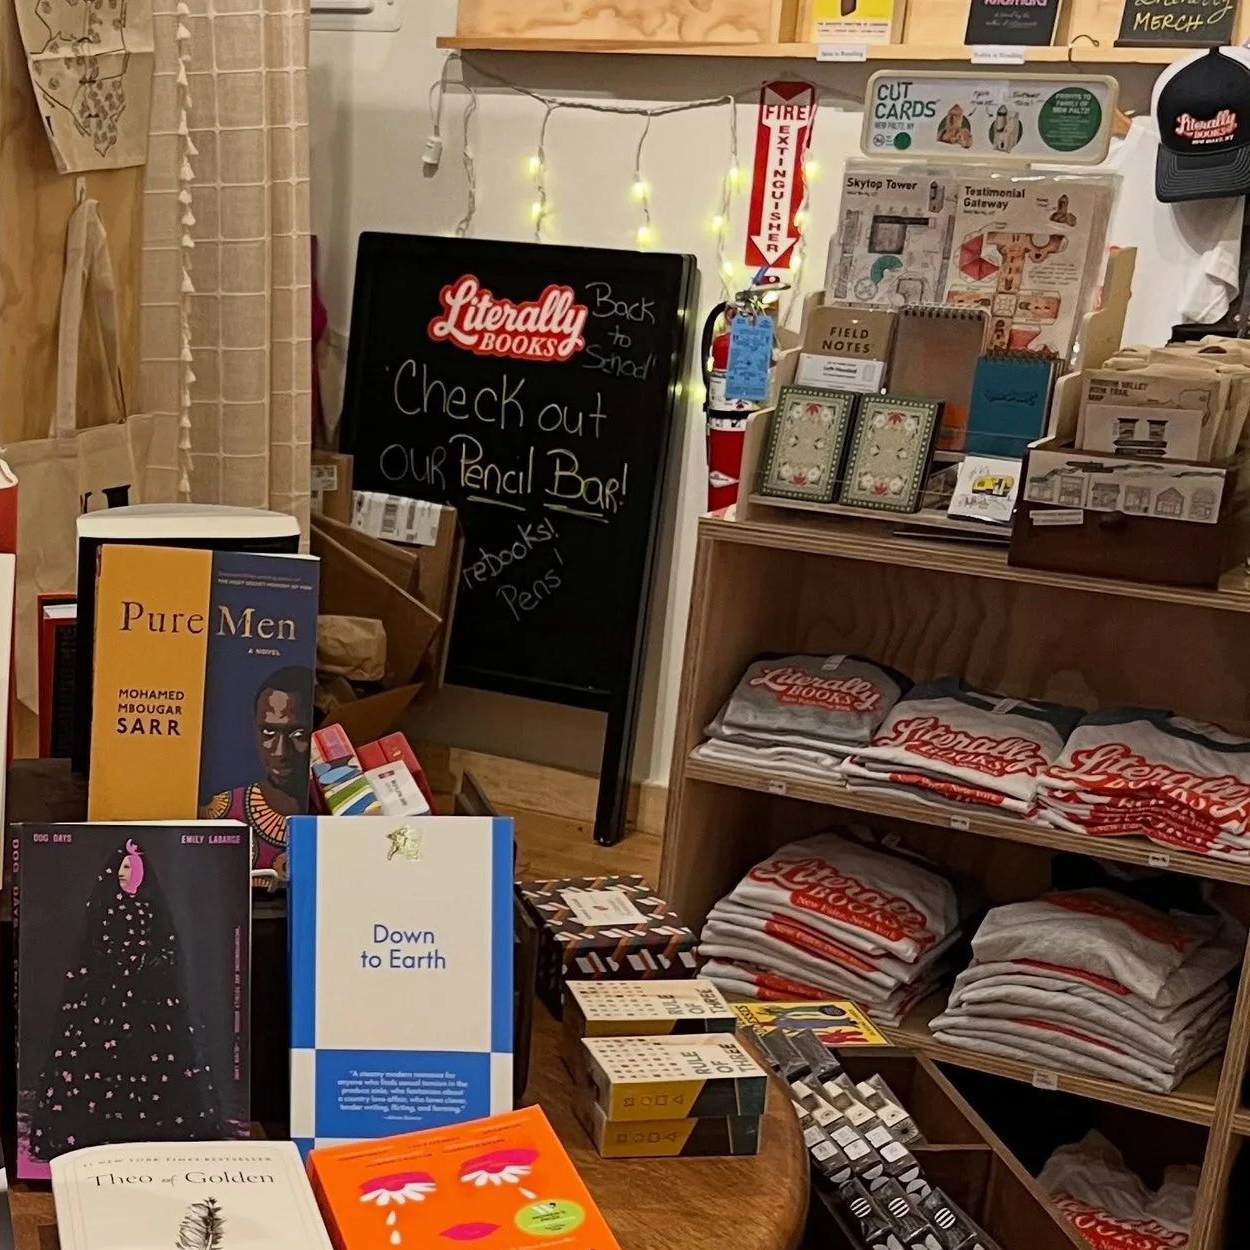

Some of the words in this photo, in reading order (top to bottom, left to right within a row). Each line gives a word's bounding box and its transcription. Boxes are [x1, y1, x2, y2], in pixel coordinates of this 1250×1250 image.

[1134, 12, 1203, 32] MERCH
[877, 81, 914, 101] CUT
[765, 105, 807, 121] FIRE
[874, 100, 936, 120] CARDS
[767, 125, 791, 253] EXTINGUISHER
[847, 178, 883, 191] Skytop
[885, 178, 918, 190] Tower
[964, 185, 1025, 199] Testimonial
[963, 197, 1009, 210] Gateway
[585, 281, 655, 324] Back
[433, 279, 589, 357] Literally
[608, 325, 631, 348] to
[830, 326, 870, 339] FIELD
[479, 332, 559, 357] BOOKS
[822, 340, 871, 353] NOTES
[394, 359, 527, 430] Check
[538, 391, 608, 439] out
[449, 434, 535, 495] Pencil
[120, 601, 204, 635] Pure
[215, 605, 296, 641] Men
[118, 688, 185, 701] MOHAMED
[750, 666, 882, 711] Literally
[787, 685, 853, 706] BOOKS
[118, 703, 182, 715] MBOUGAR
[117, 717, 181, 736] SARR
[877, 718, 1046, 776] Literally
[33, 834, 49, 843] DOG
[53, 834, 72, 843] DAYS
[181, 834, 204, 844] EMILY
[373, 924, 435, 945] Down
[361, 950, 382, 969] to
[390, 949, 446, 970] Earth
[681, 1051, 711, 1075] RULE
[711, 1058, 735, 1074] OF
[718, 1043, 756, 1073] THREE
[87, 1173, 153, 1187] Theo
[161, 1173, 177, 1187] of
[185, 1171, 275, 1184] Golden
